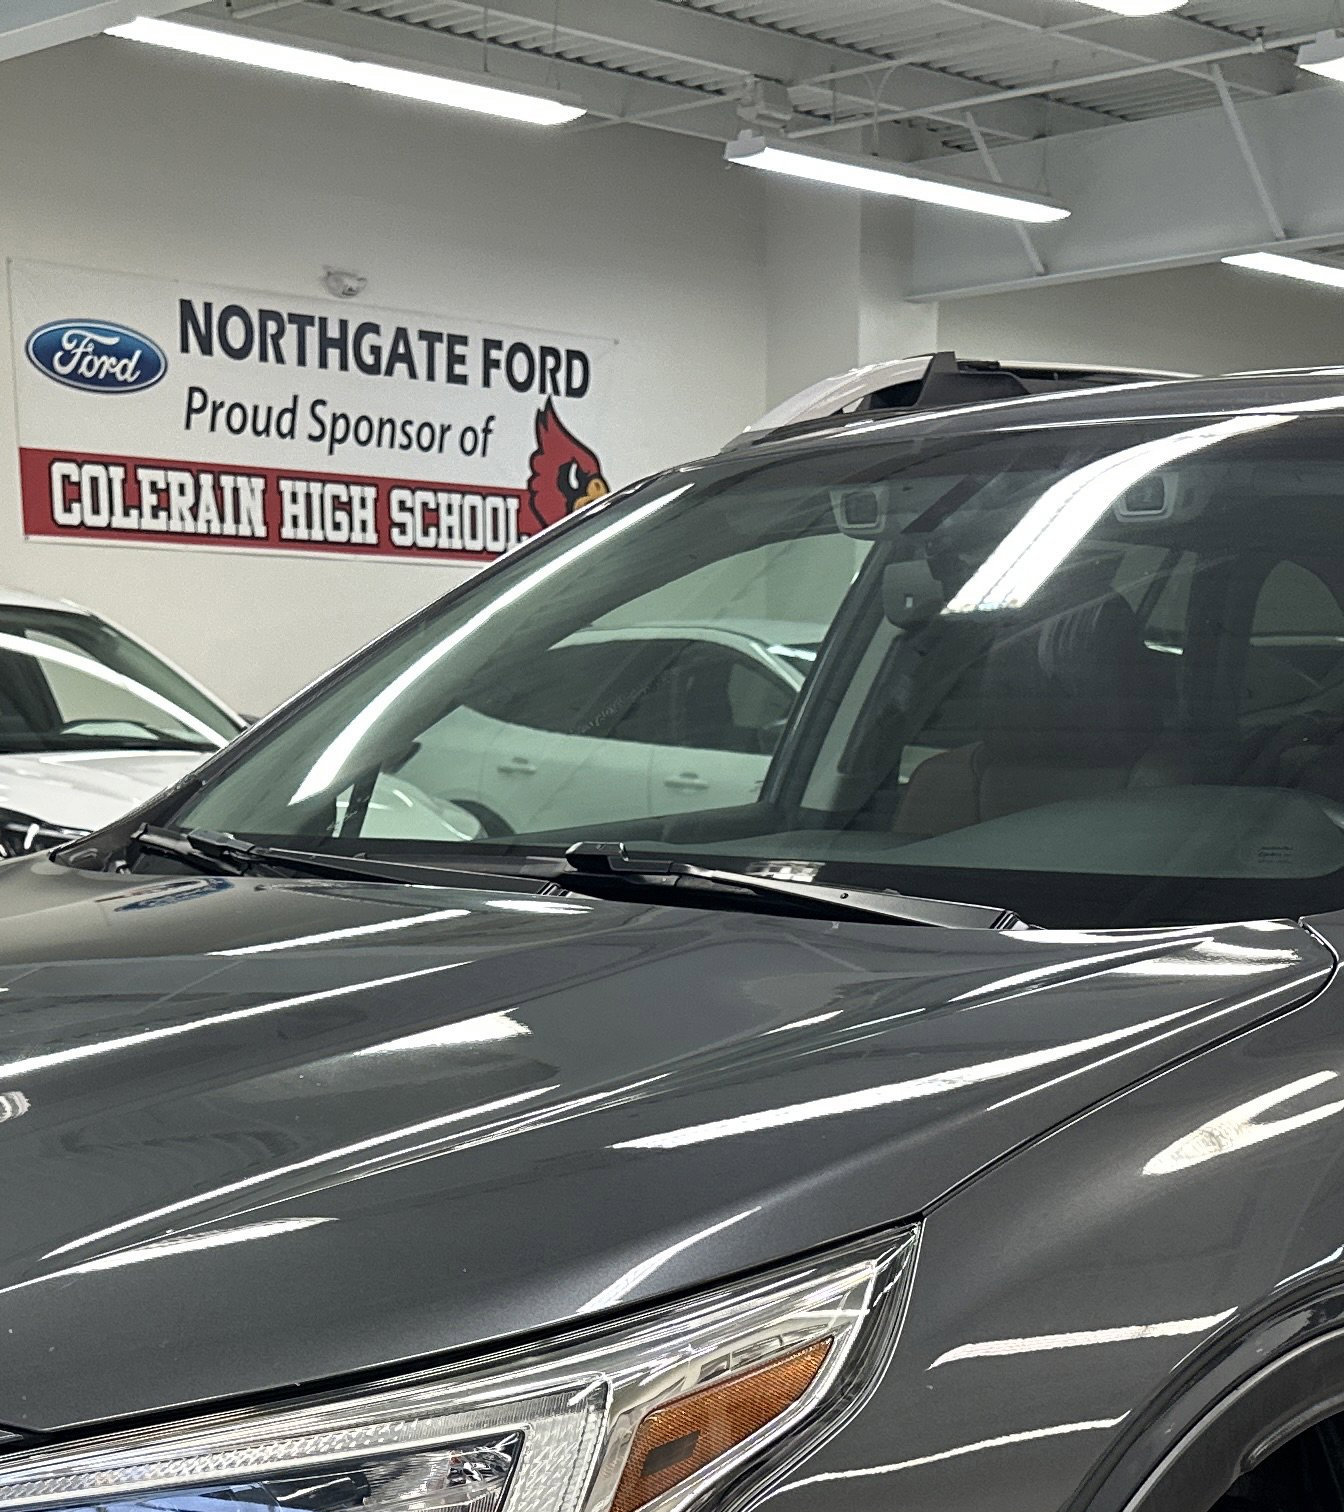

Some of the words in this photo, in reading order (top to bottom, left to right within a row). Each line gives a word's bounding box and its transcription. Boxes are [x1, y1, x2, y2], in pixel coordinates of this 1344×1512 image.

[52, 329, 143, 384] Ford
[179, 298, 470, 387] NORTHGATE
[482, 337, 590, 399] FORD
[184, 386, 300, 441] Proud
[307, 398, 452, 456] Sponsor
[459, 414, 496, 458] of
[50, 460, 268, 539] COLERAIN
[278, 477, 379, 545] HIGH
[388, 487, 532, 553] SCHOOL
